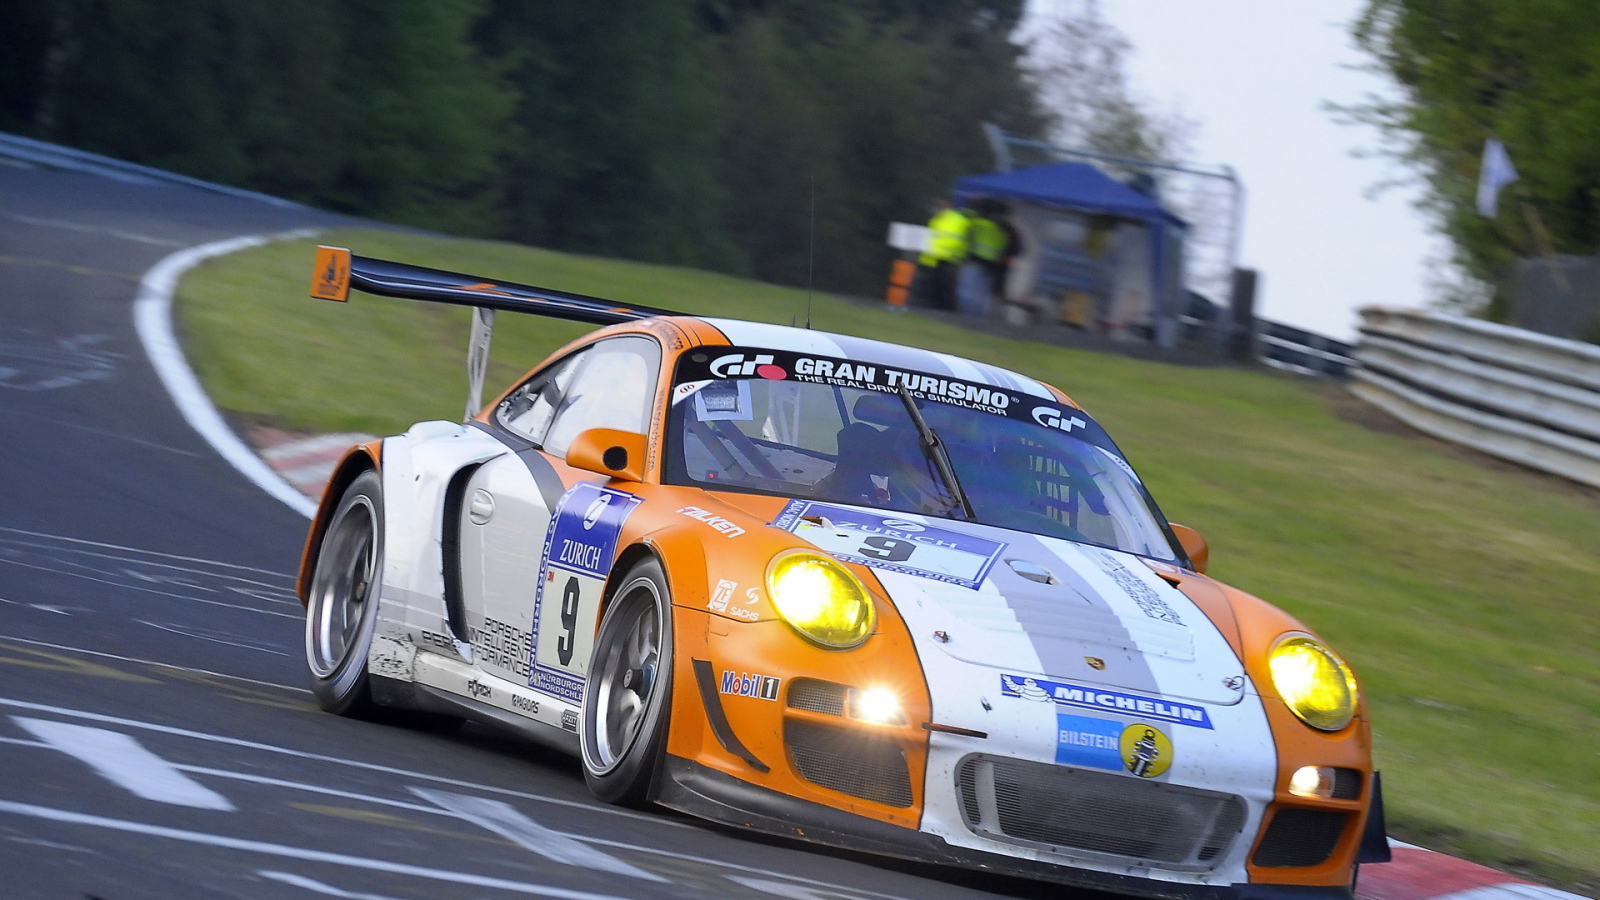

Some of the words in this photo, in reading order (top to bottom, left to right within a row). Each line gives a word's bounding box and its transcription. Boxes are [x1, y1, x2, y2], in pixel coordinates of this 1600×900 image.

[794, 358, 875, 383] GRAN
[885, 370, 1009, 409] TURISMO
[795, 374, 826, 384] THE
[827, 378, 865, 389] REAL
[867, 383, 925, 400] DRIVNG
[929, 394, 1008, 417] SIMULATOR
[676, 506, 746, 539] FALKEN
[838, 520, 958, 549] ZURICH
[560, 538, 602, 570] ZURICH
[858, 536, 917, 562] 9
[557, 576, 580, 667] 9
[730, 606, 760, 621] SACHS
[468, 626, 531, 662] INTELLIGENT
[484, 617, 532, 647] PORSCHE
[720, 670, 760, 698] Mobil
[1054, 686, 1204, 722] MICHELIN
[1060, 730, 1119, 750] BILSTEIN
